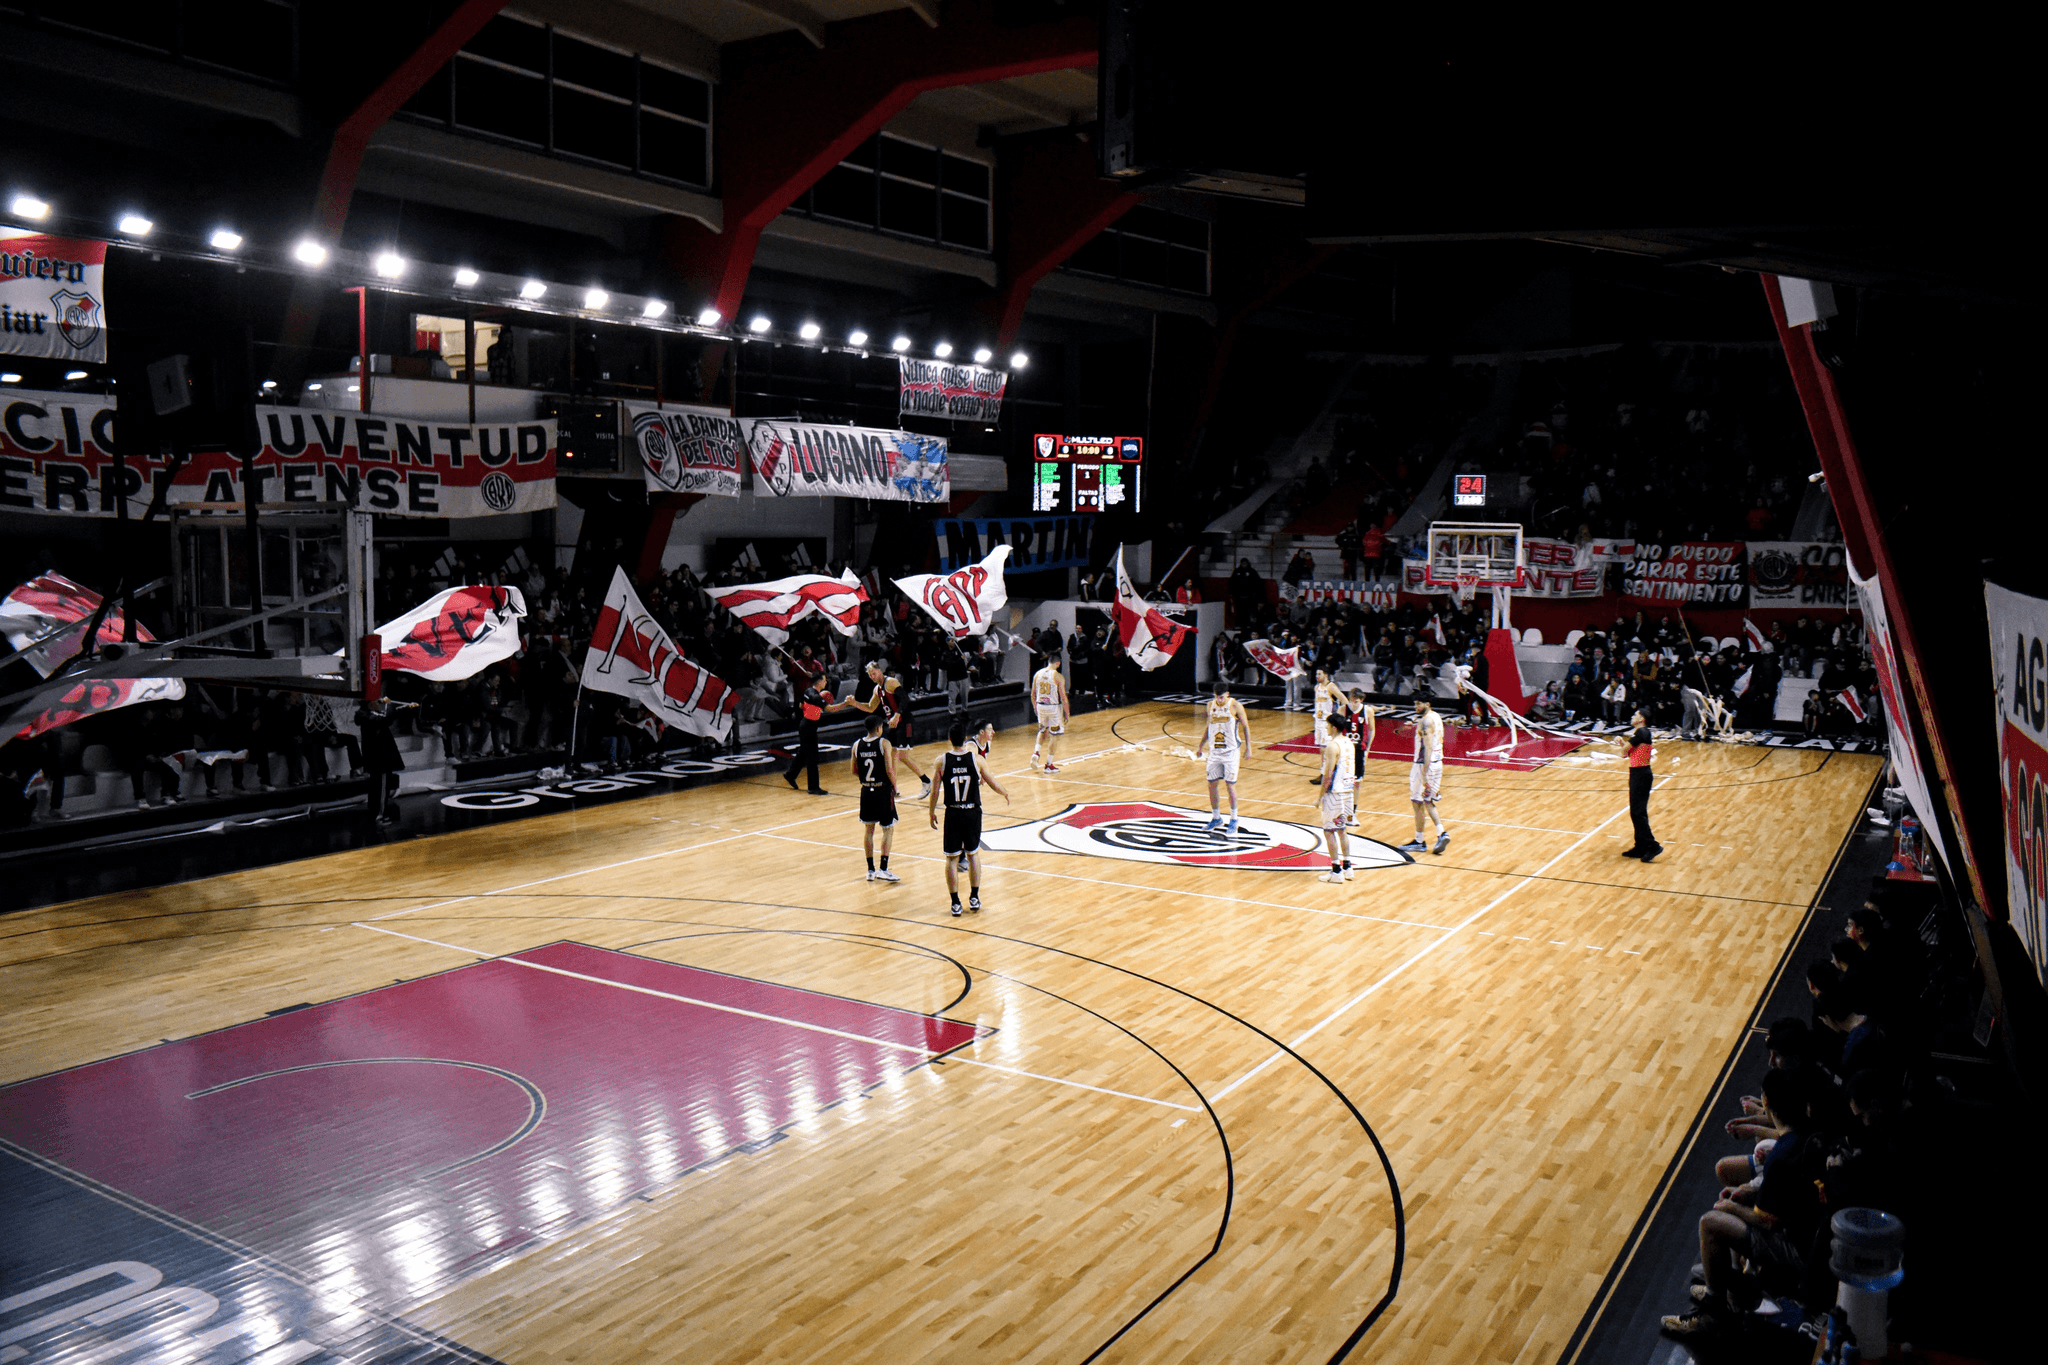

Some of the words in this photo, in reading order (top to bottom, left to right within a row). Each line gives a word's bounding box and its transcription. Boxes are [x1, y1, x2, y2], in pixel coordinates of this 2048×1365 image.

[902, 359, 938, 386] Nunca
[941, 367, 971, 390] quise
[902, 389, 911, 411] a
[914, 387, 946, 413] nadie
[949, 395, 980, 417] como
[227, 412, 548, 468] UVENTUD
[595, 432, 616, 440] VISITA
[668, 414, 691, 443] LA
[1071, 436, 1114, 445] MULTILED
[682, 440, 709, 465] DEL
[705, 439, 737, 469] TIO
[790, 427, 889, 490] LUGANO
[1077, 446, 1100, 455] 10:00
[1085, 470, 1091, 479] 1
[1459, 477, 1483, 493] 24
[944, 516, 1091, 571] MARTIN
[1634, 543, 1663, 560] NO
[1667, 546, 1734, 563] PUEDO
[1622, 560, 1689, 580] PARAR
[1693, 563, 1742, 582] ESTE
[1622, 577, 1744, 603] SENTIMIENTO
[440, 751, 776, 810] Grande
[864, 758, 876, 782] 2
[950, 775, 971, 803] 17
